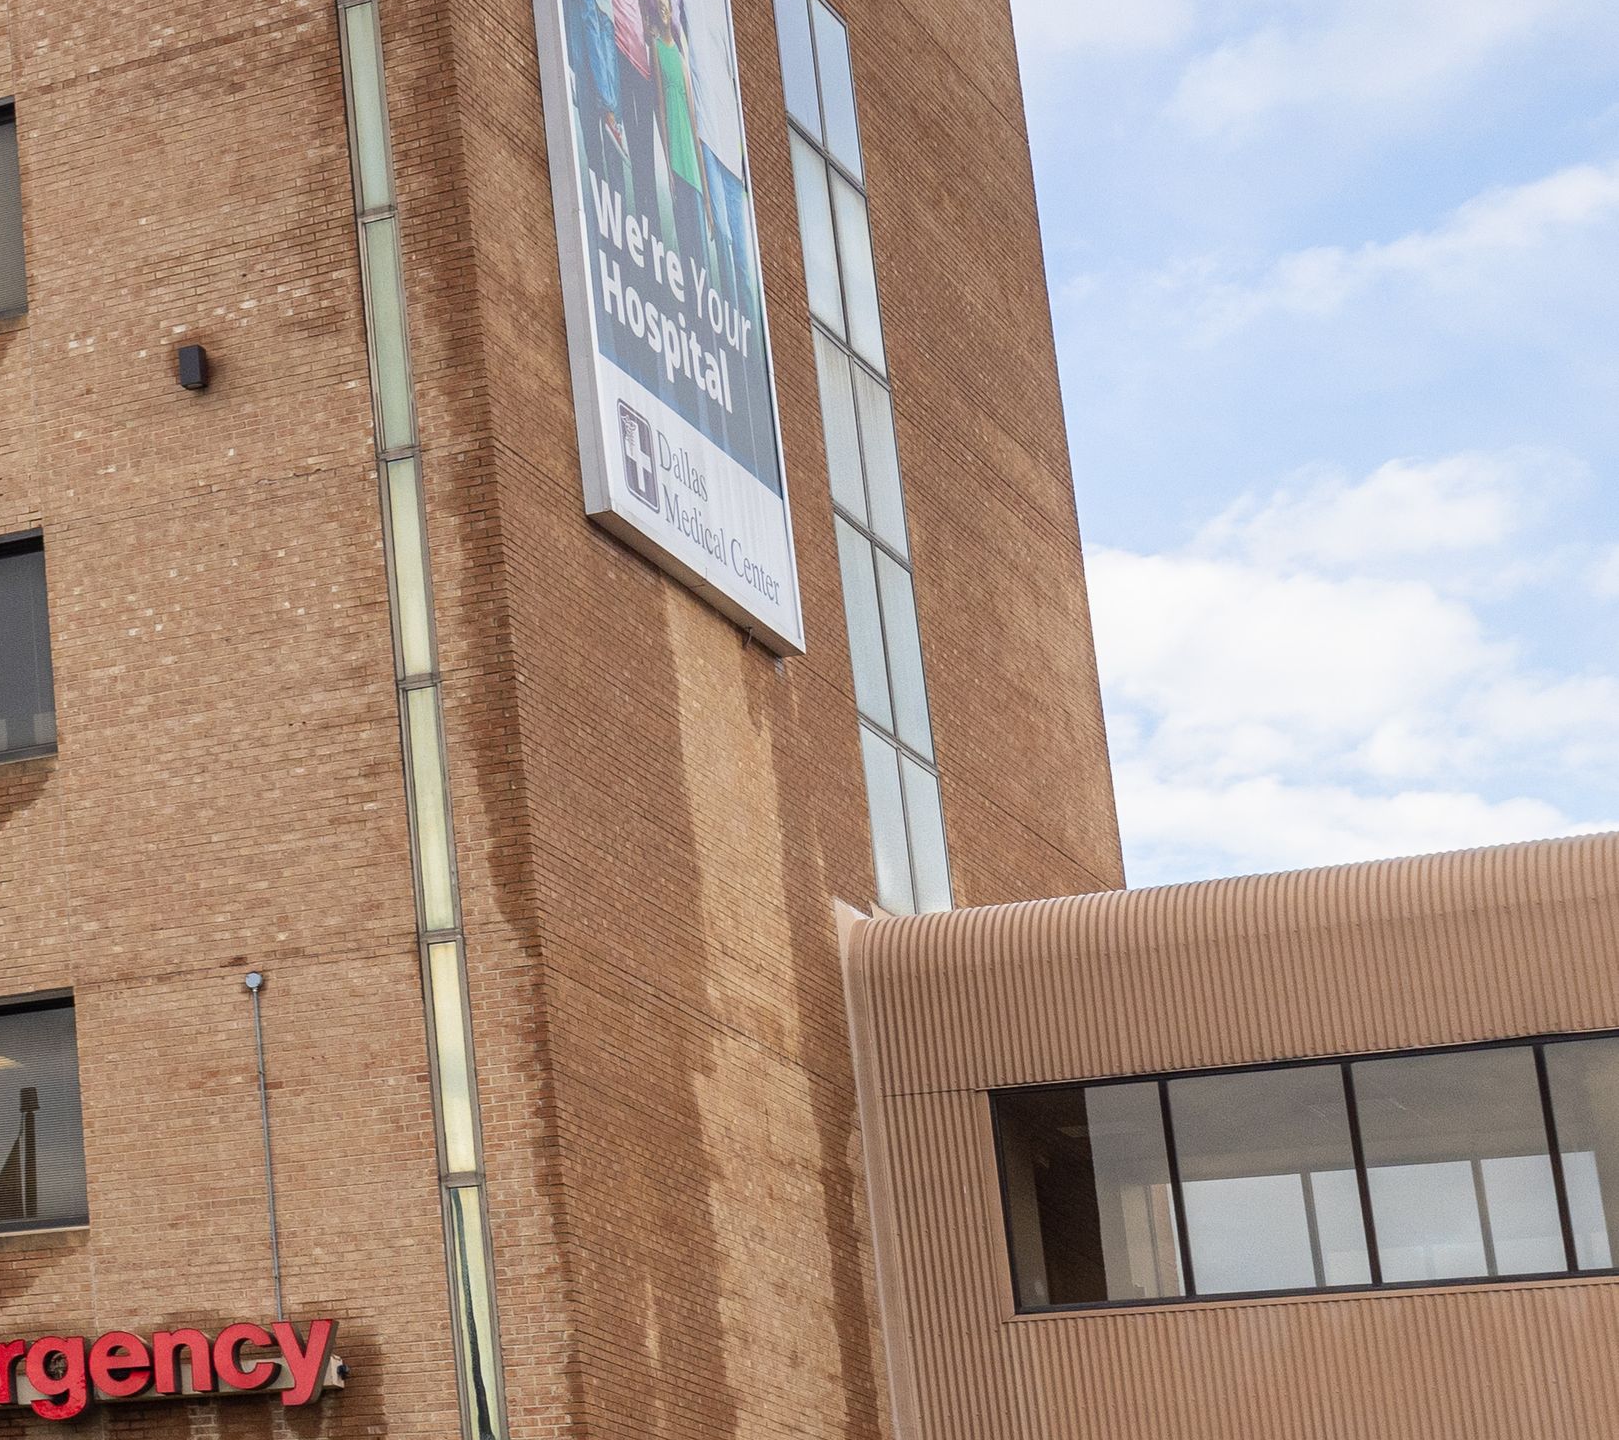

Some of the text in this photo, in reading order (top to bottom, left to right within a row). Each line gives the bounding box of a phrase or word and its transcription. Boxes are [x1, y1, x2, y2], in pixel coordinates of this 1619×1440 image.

[589, 168, 751, 357] We're Your
[599, 249, 732, 414] Hospital
[656, 429, 709, 502] Dallas
[662, 483, 781, 606] Medical Center
